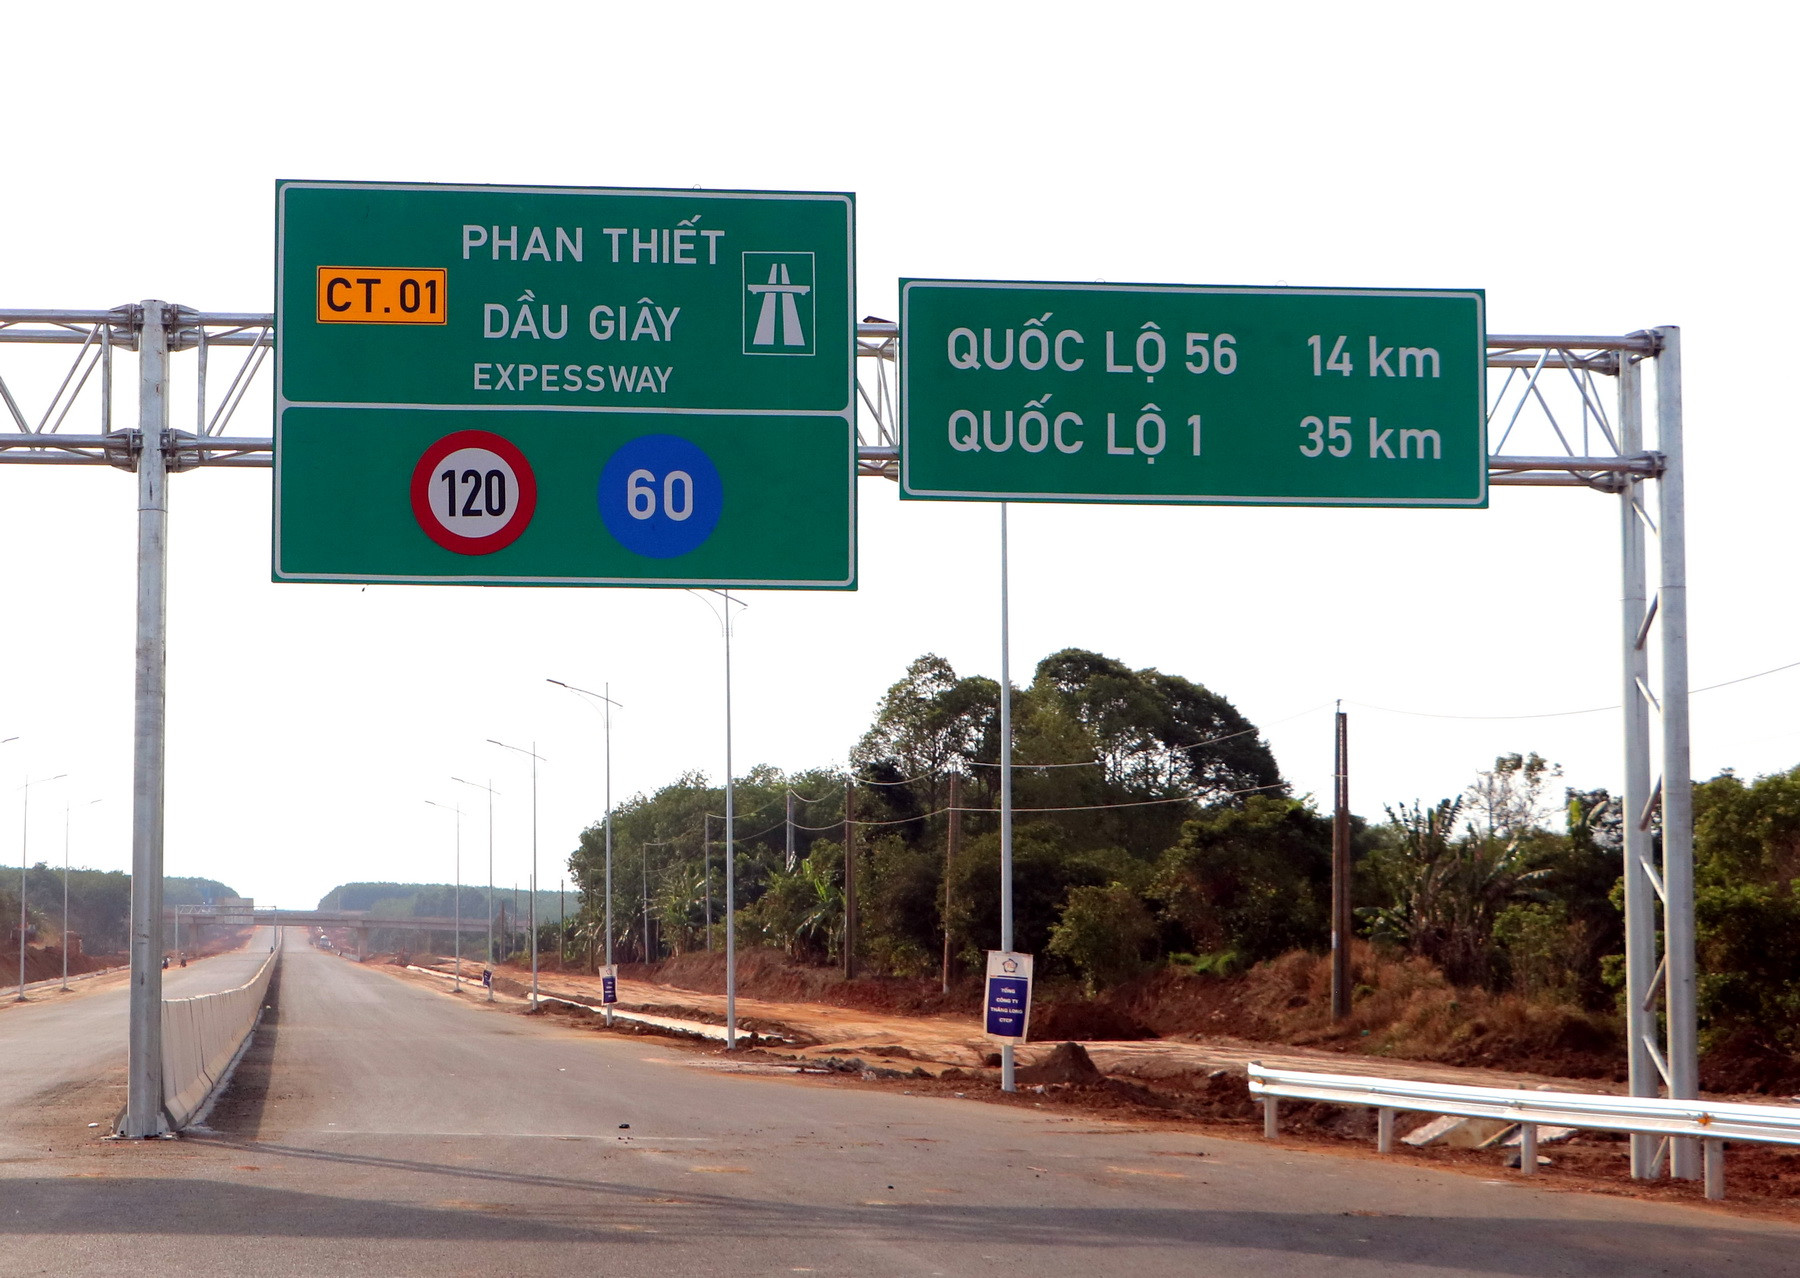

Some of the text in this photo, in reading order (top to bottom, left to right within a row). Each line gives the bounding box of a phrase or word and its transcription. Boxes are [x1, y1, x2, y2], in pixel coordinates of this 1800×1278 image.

[462, 214, 725, 265] PHAN THIẾT
[327, 278, 436, 314] CT.01
[483, 289, 681, 342] DẦU GIÂY
[947, 312, 1440, 383] QUỐC LỘ 56 14 km
[474, 363, 673, 393] EXPESSWAY
[948, 393, 1441, 465] QUỐC LỘ 1 35 km
[441, 469, 506, 517] 120
[627, 468, 694, 522] 60
